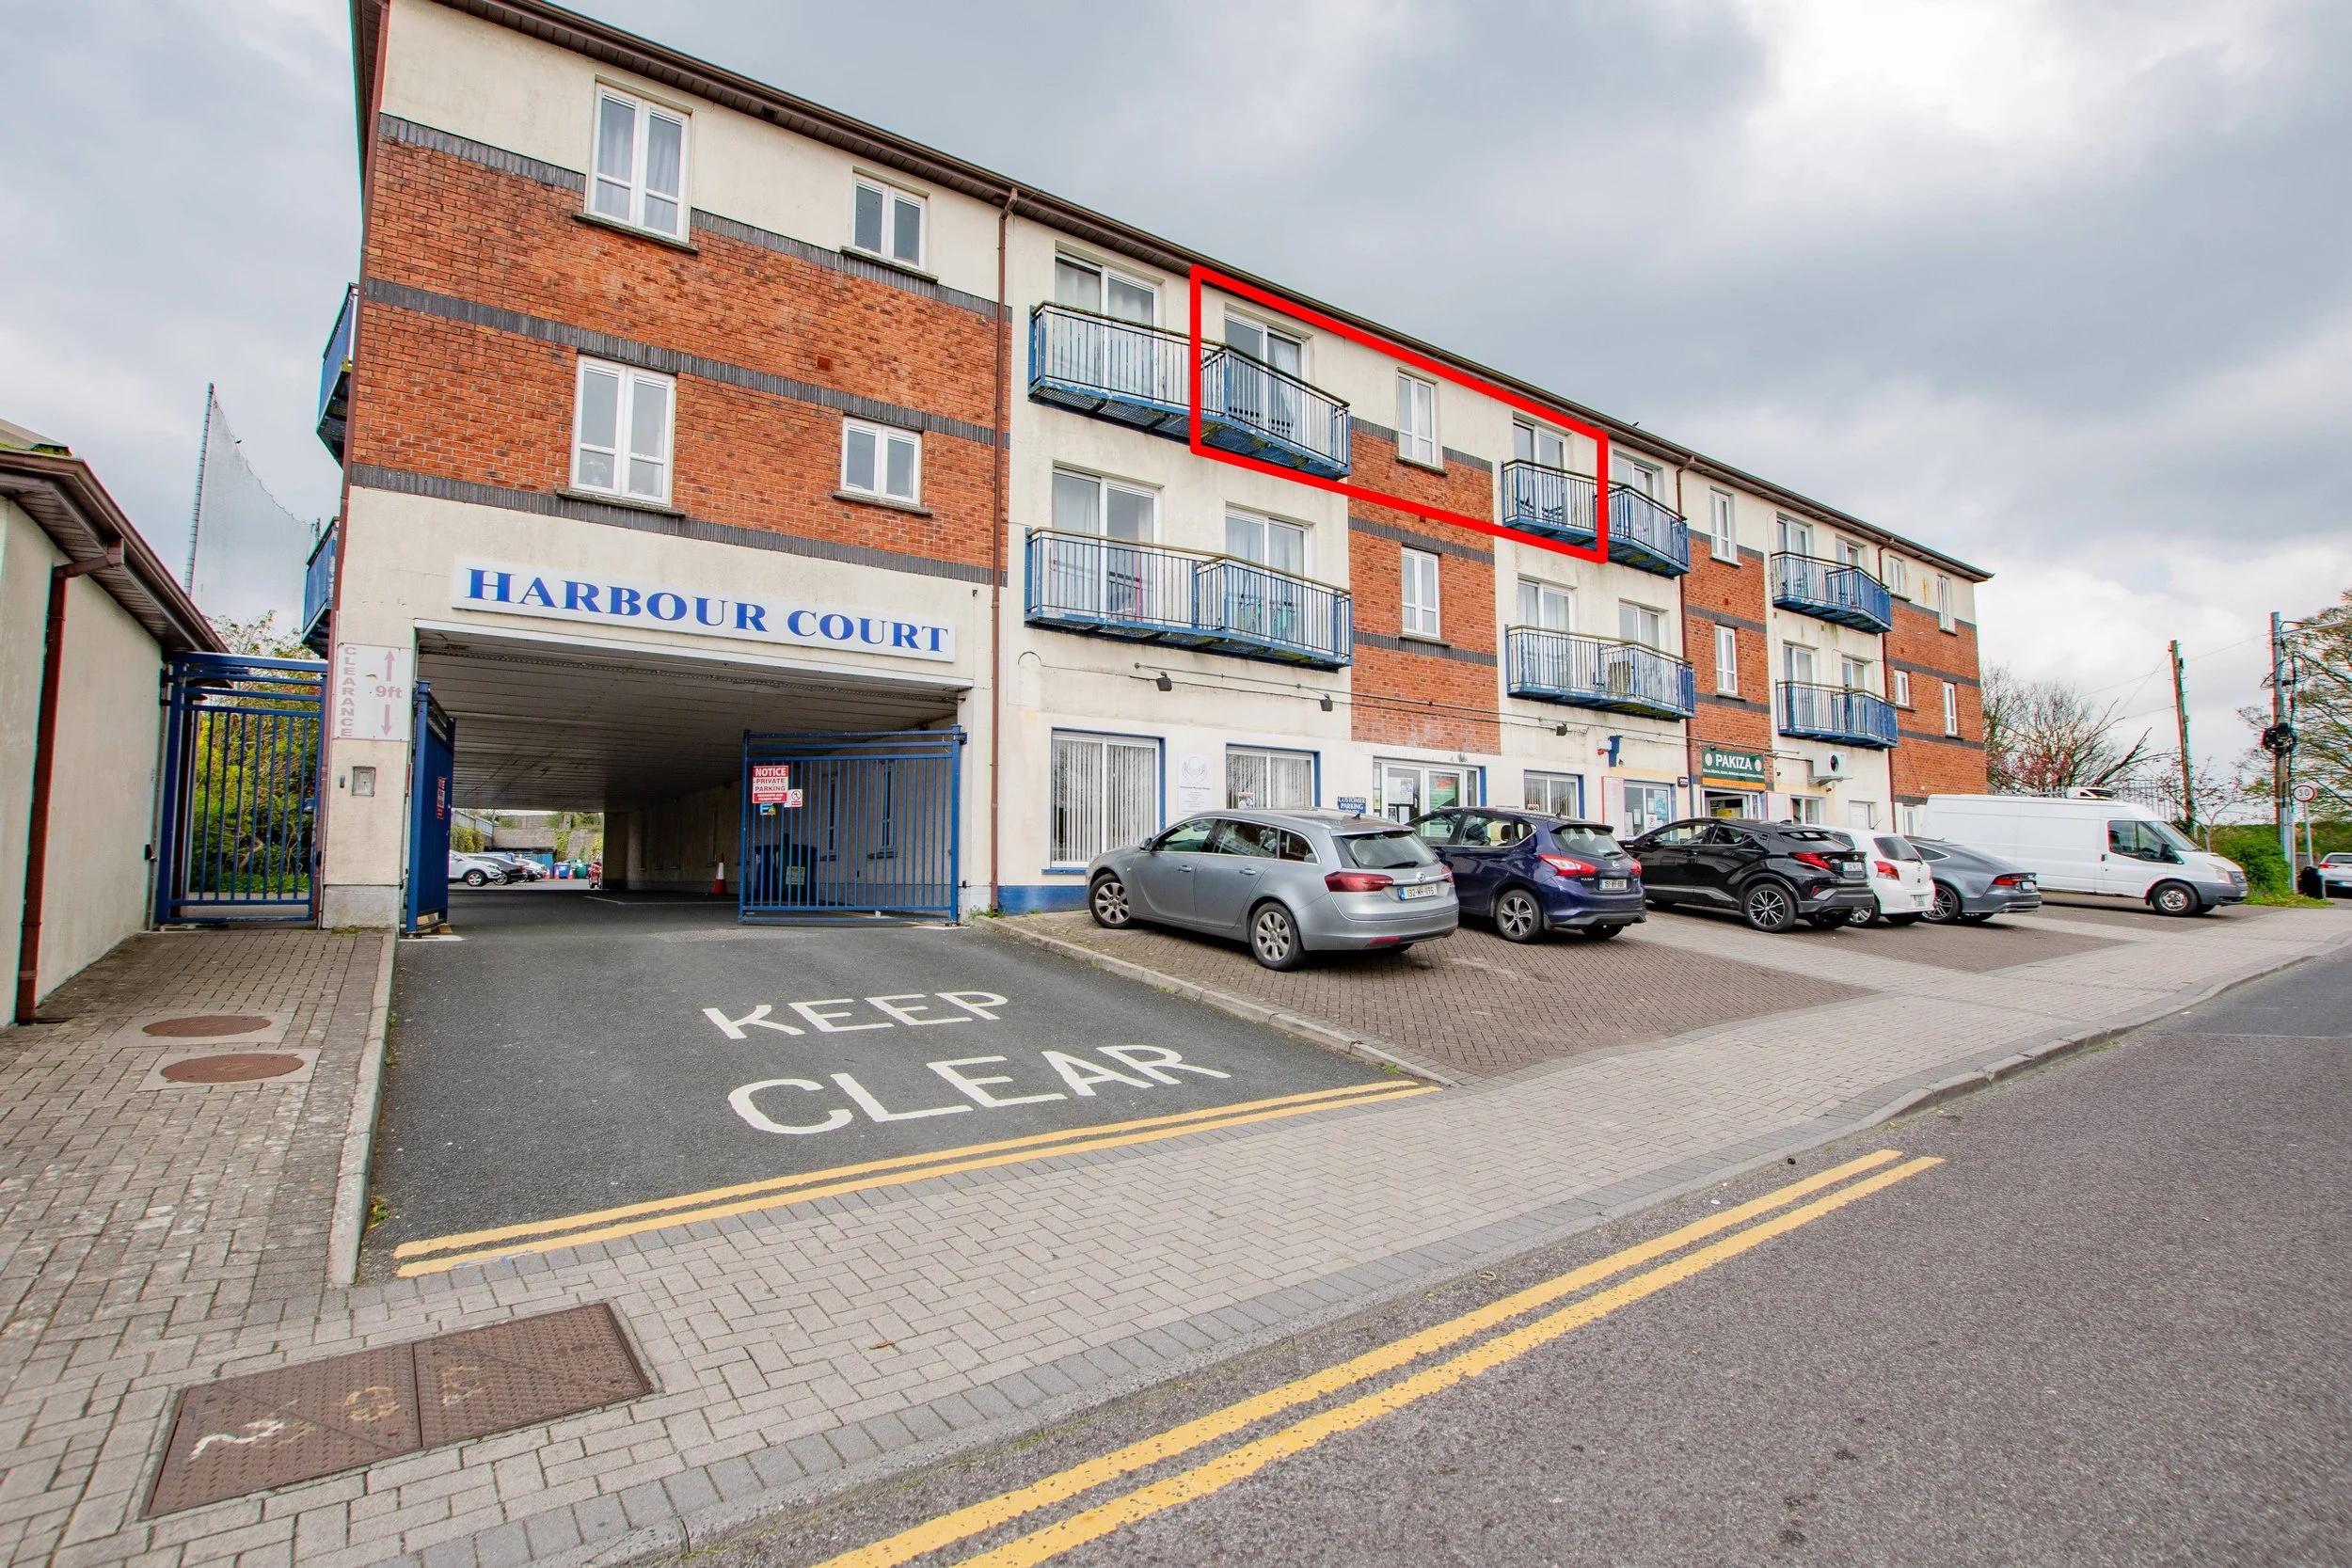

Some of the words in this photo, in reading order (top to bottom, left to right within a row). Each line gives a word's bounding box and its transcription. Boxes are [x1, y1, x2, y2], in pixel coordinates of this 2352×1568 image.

[466, 568, 769, 633] HARBOUR
[787, 610, 949, 653] COURT
[341, 646, 357, 736] CLEARANCE
[375, 685, 403, 699] 9ft
[755, 768, 787, 777] NOTICE
[1715, 753, 1753, 770] PAKIZA
[702, 990, 1009, 1039] KEEP
[727, 1044, 1232, 1135] CLEAR
